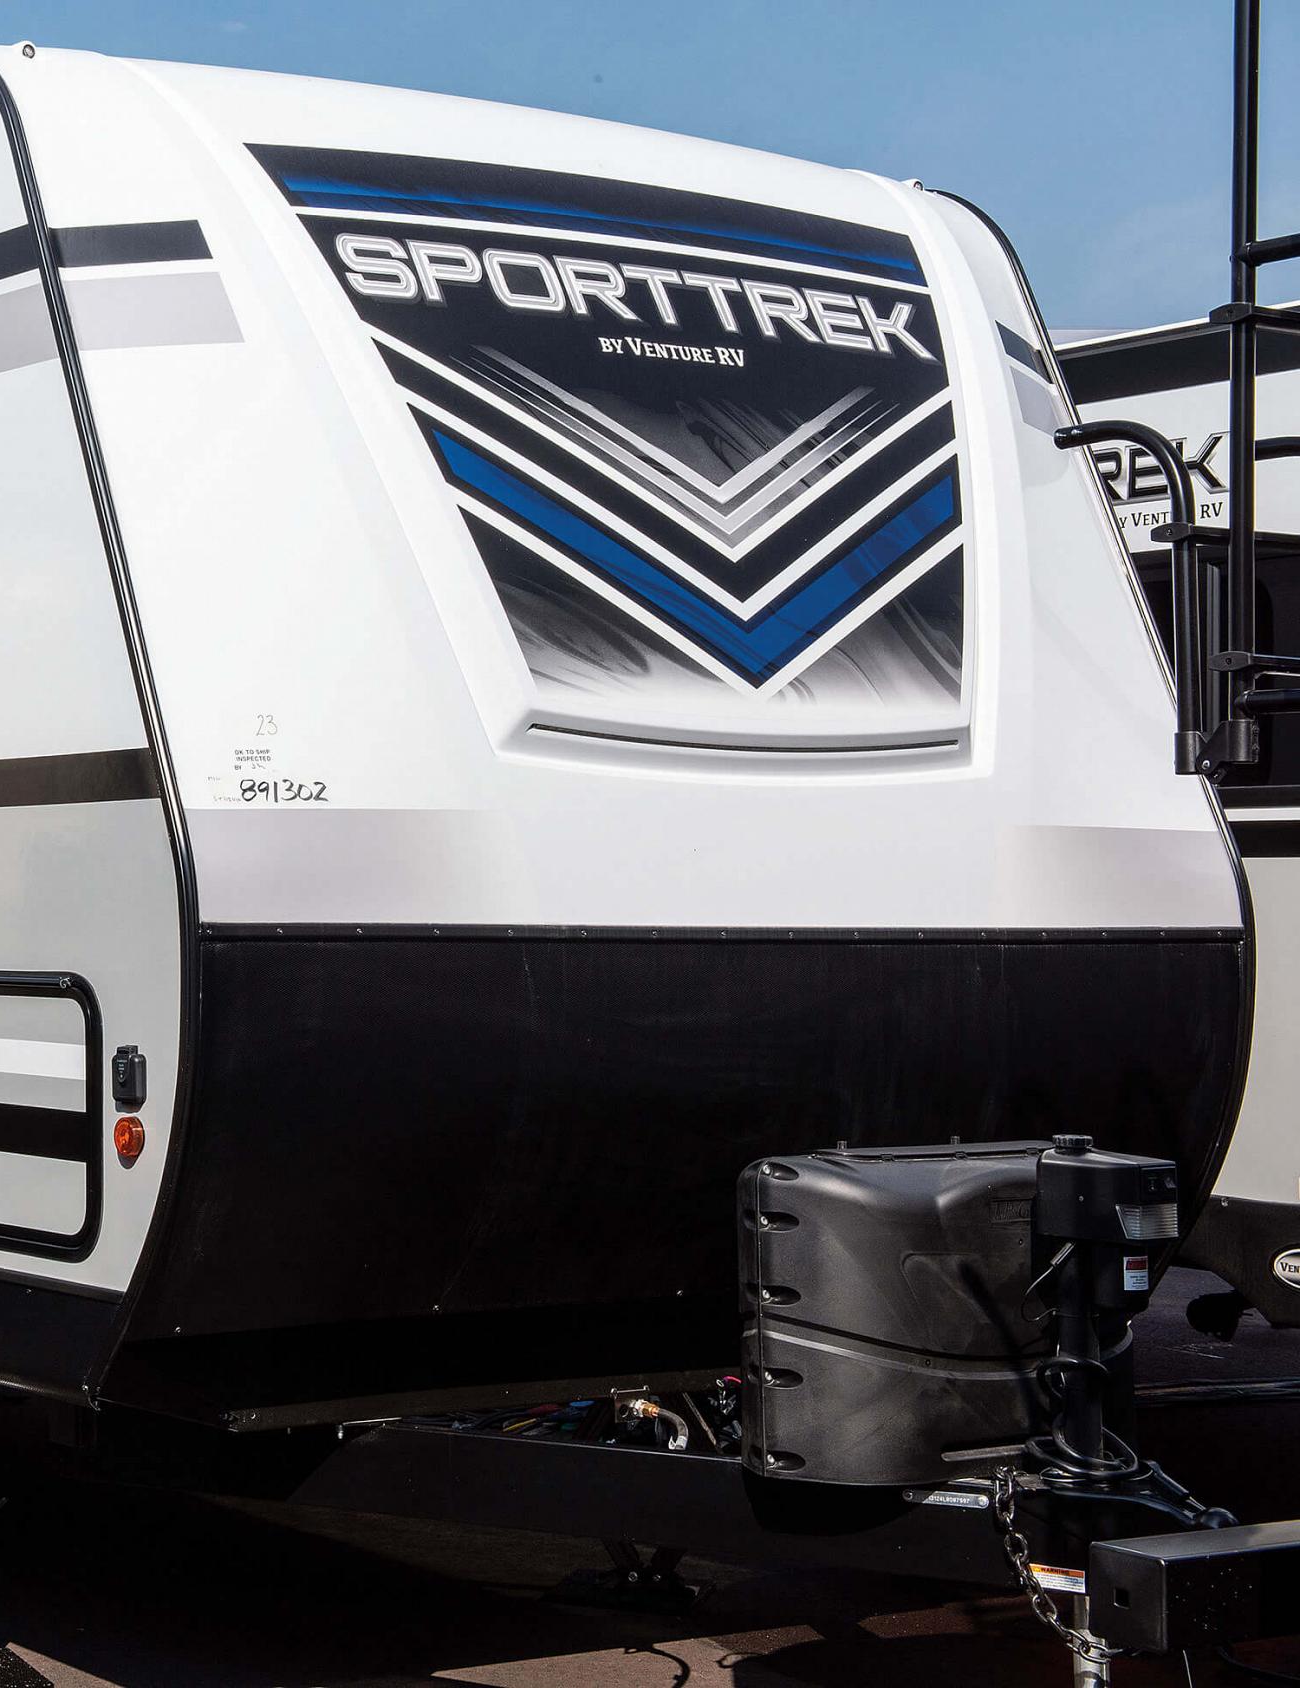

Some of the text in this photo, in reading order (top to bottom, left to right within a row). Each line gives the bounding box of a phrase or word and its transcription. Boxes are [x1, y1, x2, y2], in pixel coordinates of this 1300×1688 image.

[335, 232, 938, 362] SPORTTREK
[599, 337, 623, 354] BY
[715, 346, 744, 367] RV
[1131, 512, 1169, 527] VENT
[1200, 502, 1223, 519] RV
[240, 778, 329, 803] 891302
